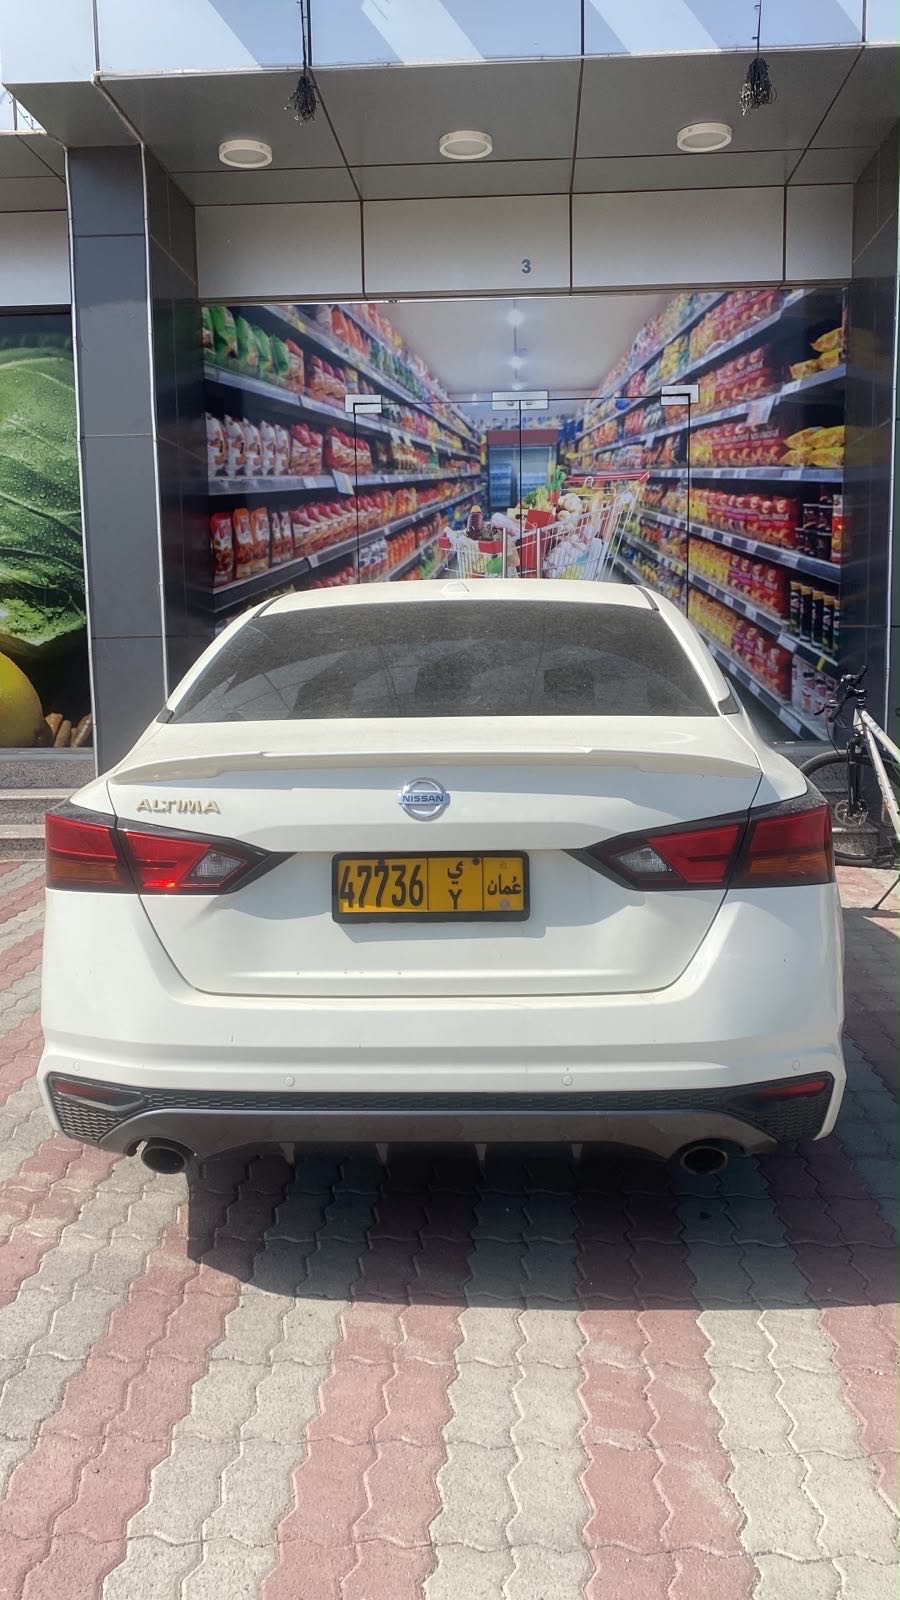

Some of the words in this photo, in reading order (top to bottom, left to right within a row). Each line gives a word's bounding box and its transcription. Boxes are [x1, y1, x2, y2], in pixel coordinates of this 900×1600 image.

[521, 258, 531, 274] 3
[136, 798, 222, 815] ALTIMA
[402, 794, 444, 803] NISSAN
[447, 860, 464, 885] ي
[339, 864, 424, 908] 47736
[447, 889, 463, 910] Y
